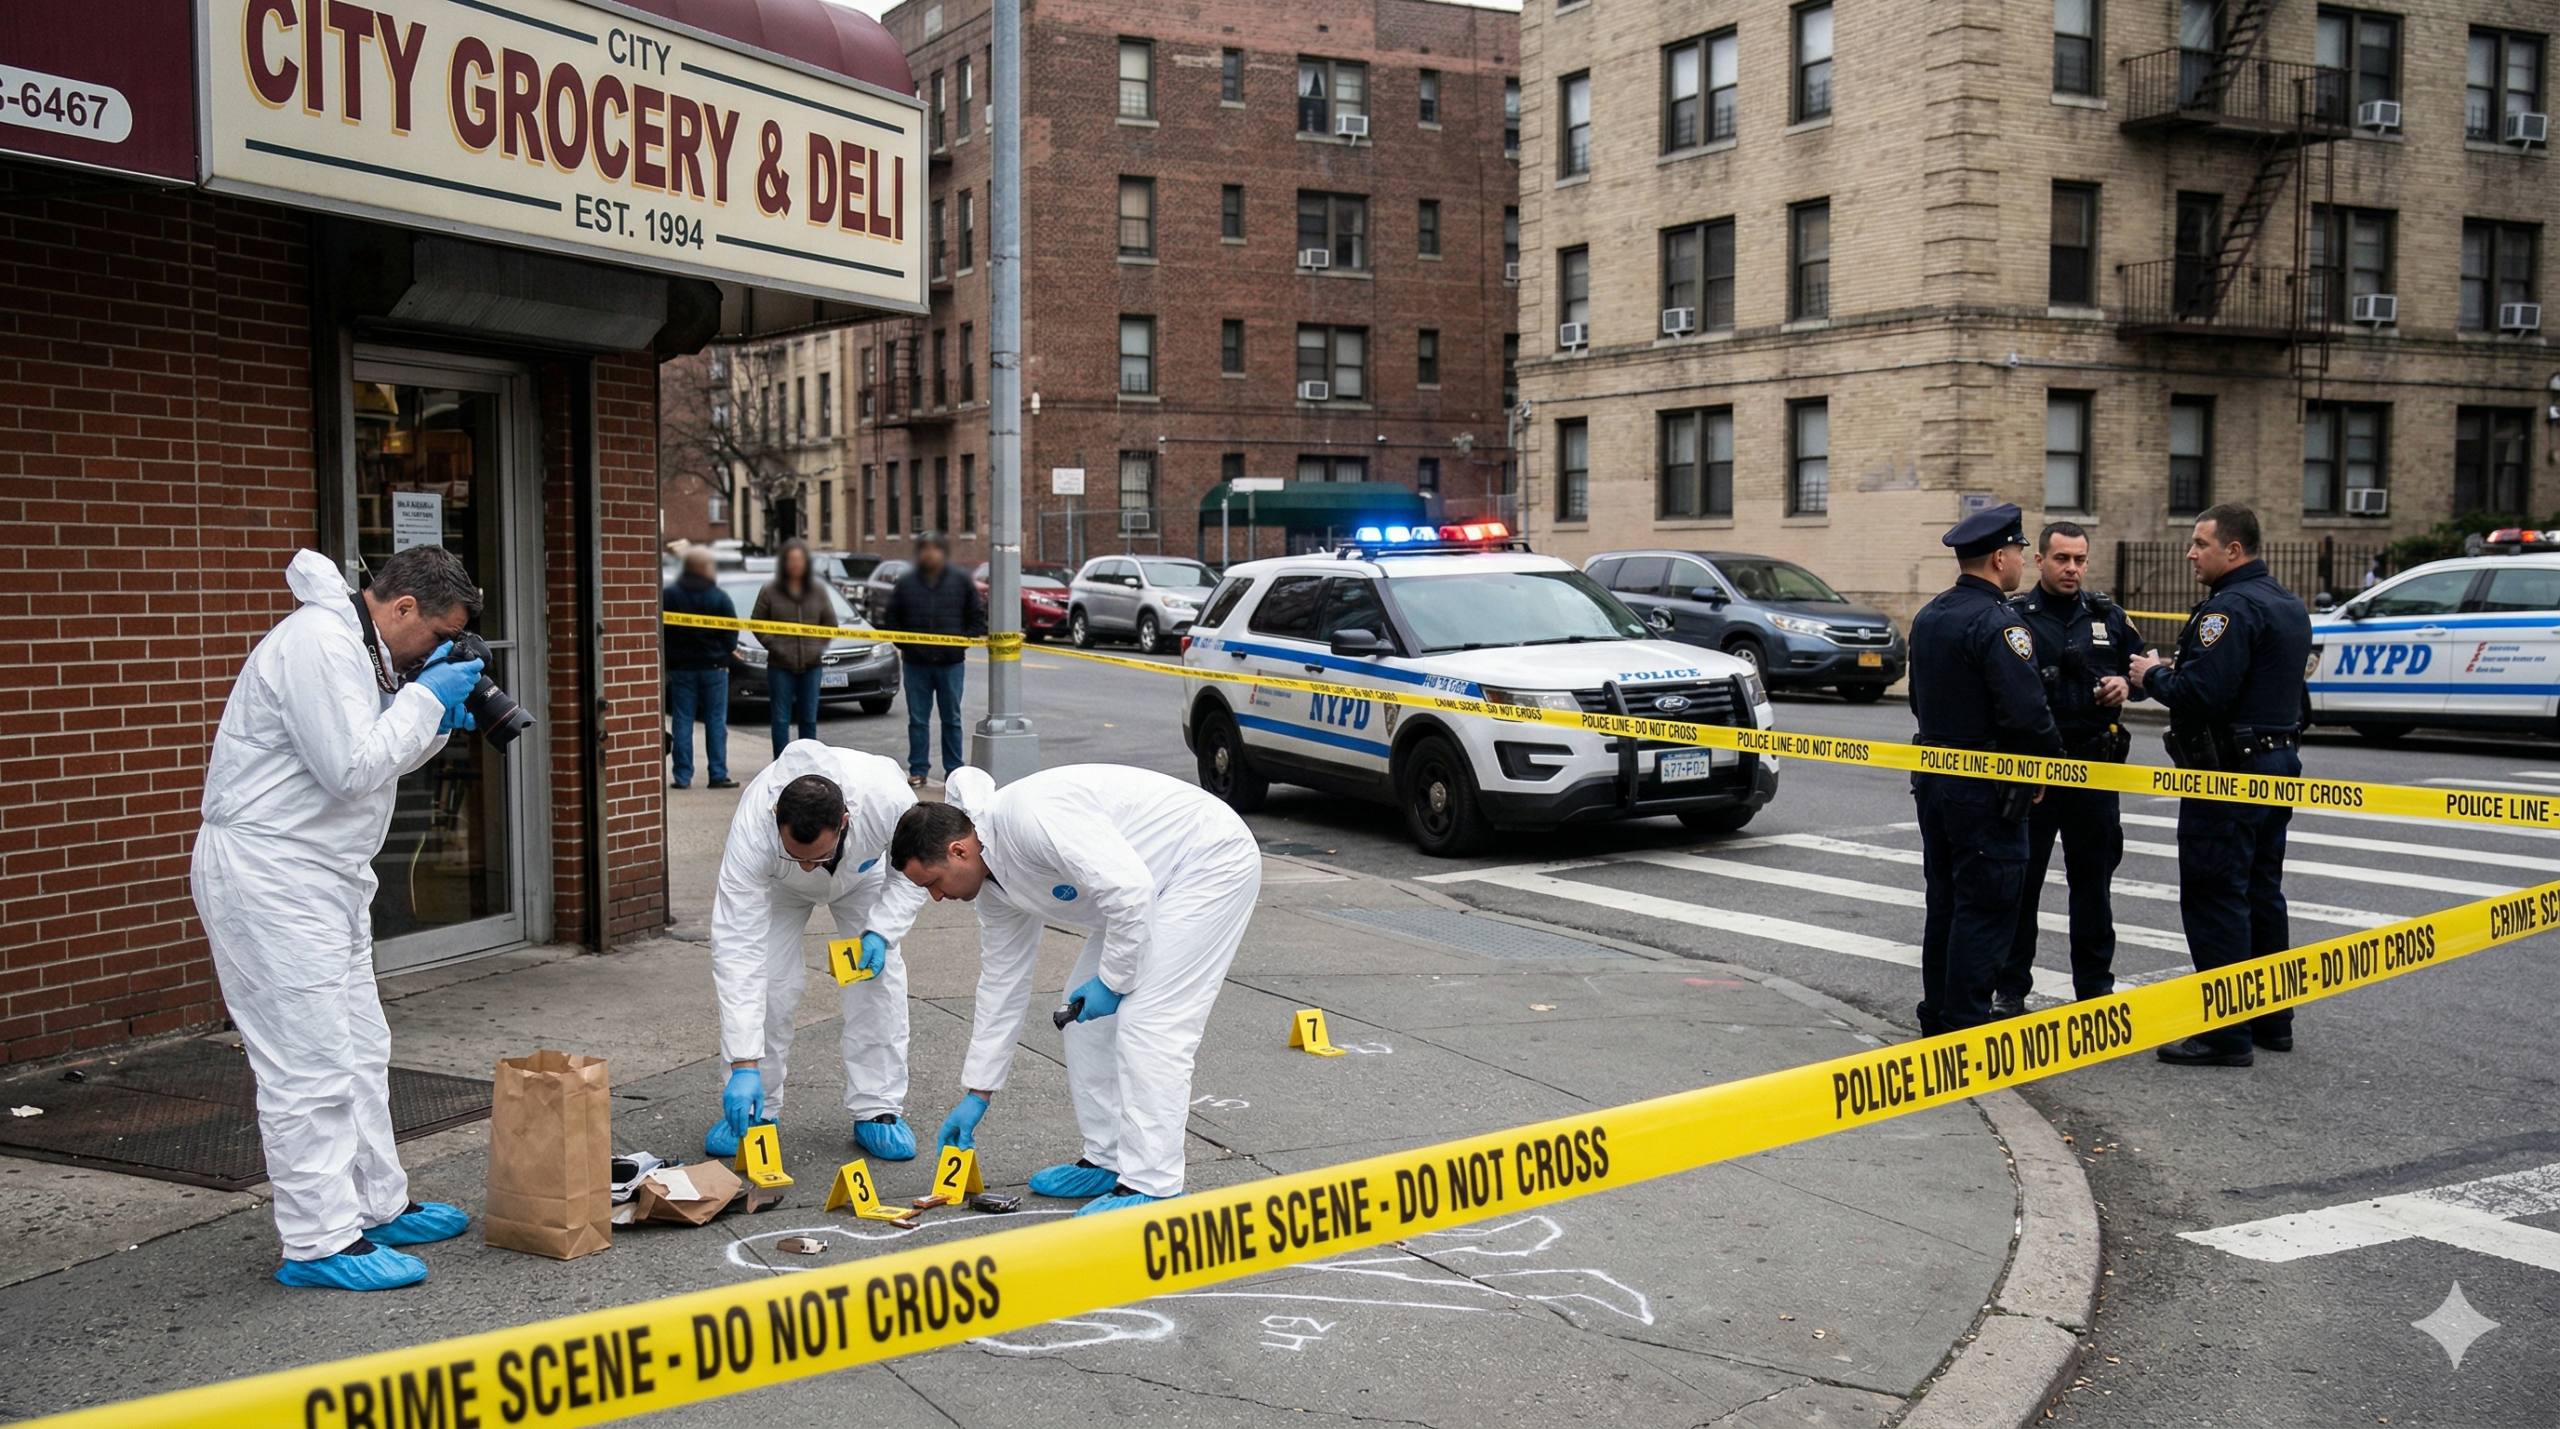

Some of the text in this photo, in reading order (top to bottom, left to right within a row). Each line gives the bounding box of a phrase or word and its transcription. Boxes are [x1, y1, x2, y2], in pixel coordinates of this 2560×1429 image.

[608, 28, 671, 76] CITY
[242, 0, 904, 242] CITY GROCERY & DELI
[575, 193, 705, 250] EST. 1994
[1617, 668, 1702, 682] POLICE
[2334, 644, 2433, 676] NYPD
[1309, 692, 1371, 731] NYPD
[1582, 714, 1610, 730] POLICE
[1649, 722, 1667, 737] NOT
[1668, 724, 1698, 741] CROSS
[1737, 731, 1769, 750] POLICE
[1812, 739, 1833, 757] NOT
[1835, 742, 1870, 761] CROSS
[1921, 750, 1960, 770] POLICE
[2017, 760, 2042, 779] NOT
[2045, 762, 2088, 784] CROSS
[2153, 771, 2202, 794] POLICE
[2274, 780, 2306, 803] NOT
[2310, 783, 2363, 808] CROSS
[2446, 793, 2503, 819] POLICE
[2490, 896, 2537, 941] CRIME
[842, 946, 857, 971] 1
[2201, 968, 2266, 1023] POLICE
[2347, 938, 2380, 982] NOT
[2384, 923, 2436, 971] CROSS
[1306, 1017, 1318, 1042] 7
[1832, 1056, 1916, 1120] POLICE
[2020, 1019, 2061, 1072] NOT
[2067, 1002, 2133, 1060] CROSS
[754, 1134, 768, 1166] 1
[852, 1171, 870, 1203] 3
[942, 1156, 962, 1188] 2
[1143, 1201, 1257, 1282] CRIME
[1266, 1177, 1372, 1254] SCENE
[1395, 1163, 1439, 1235] DO
[1446, 1148, 1505, 1223] NOT
[1516, 1125, 1610, 1196] CROSS
[304, 1359, 481, 1429] CRIME
[497, 1324, 656, 1424] SCENE
[692, 1306, 755, 1382] DO
[767, 1284, 850, 1365] NOT
[865, 1254, 1001, 1343] CROSS
